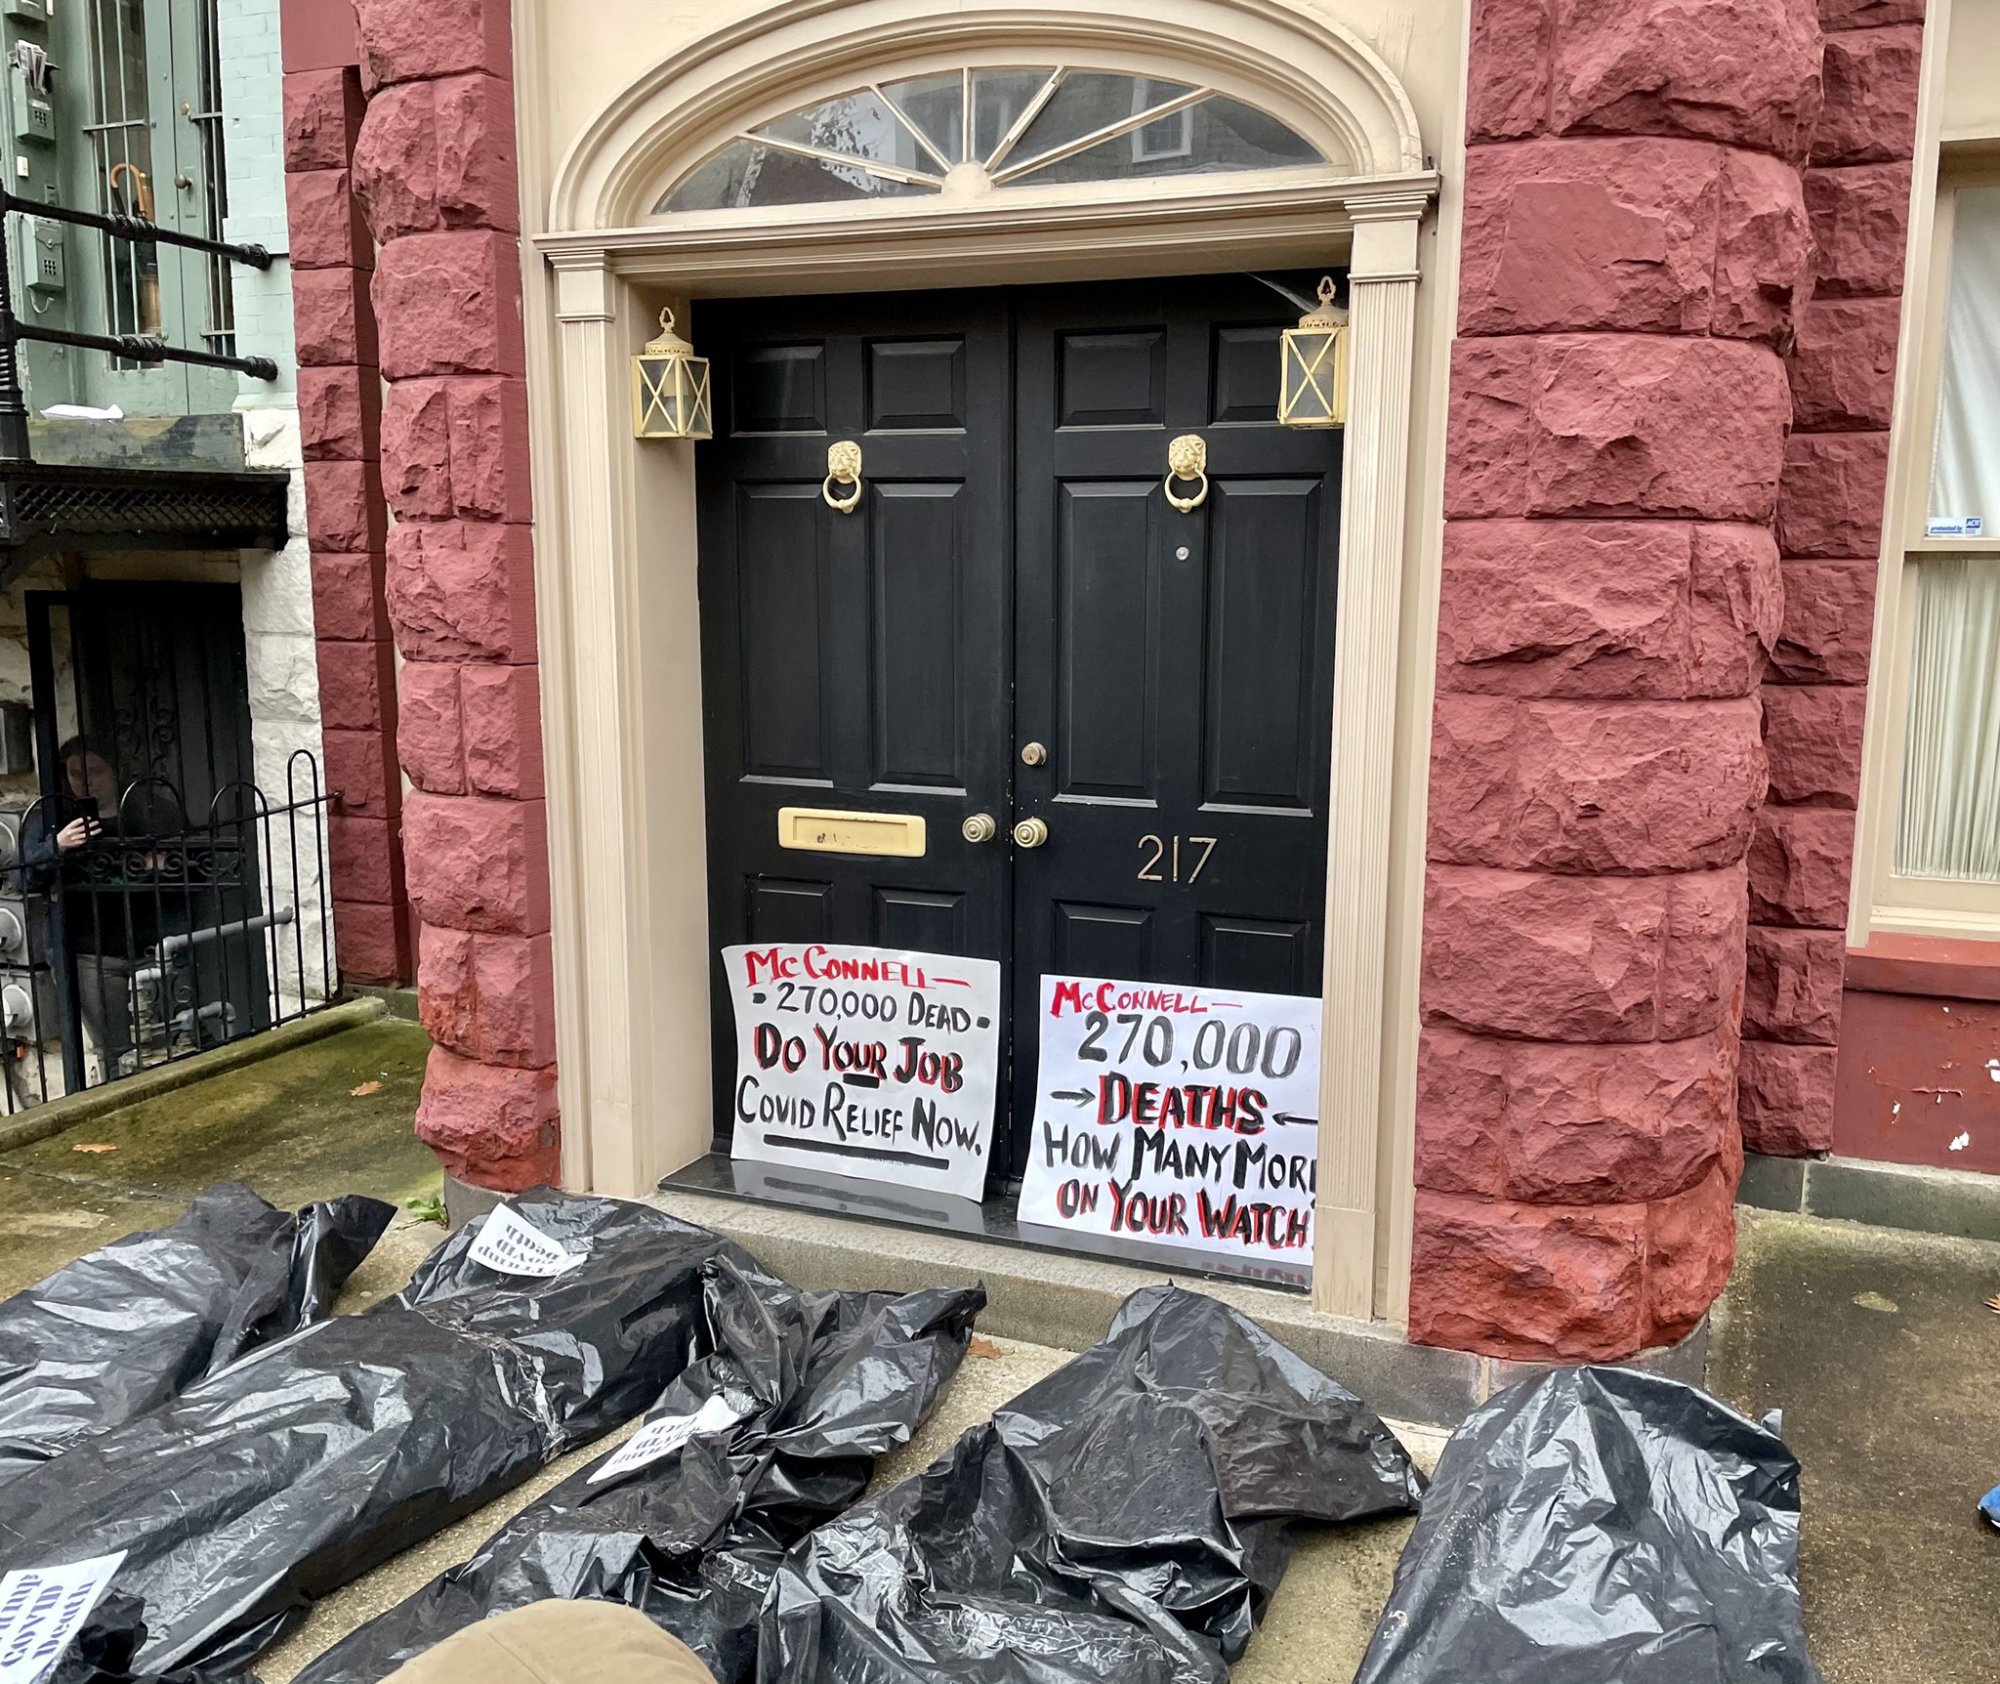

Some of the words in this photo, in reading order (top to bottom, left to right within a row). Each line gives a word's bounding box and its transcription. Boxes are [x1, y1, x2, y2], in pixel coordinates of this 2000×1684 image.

[1138, 835, 1217, 883] 217
[776, 982, 897, 1020] 270,000
[908, 992, 971, 1034] DEAD
[754, 1022, 806, 1074] DO
[813, 1023, 887, 1080] YOUR
[893, 1036, 964, 1094] JOB
[1078, 1010, 1302, 1079] 270,000
[737, 1075, 815, 1129] COVID
[822, 1081, 903, 1143] RELIEF
[911, 1097, 982, 1156] NOW.
[1097, 1070, 1268, 1135] DEATHS
[1043, 1120, 1123, 1173] HOW
[1130, 1125, 1232, 1183] MANY
[505, 1224, 560, 1261] Death
[1057, 1178, 1099, 1219] ON
[1107, 1176, 1189, 1236] YOUR
[1196, 1188, 1316, 1251] WATCH
[1, 1585, 64, 1667] COVID
[32, 1579, 97, 1660] Death
